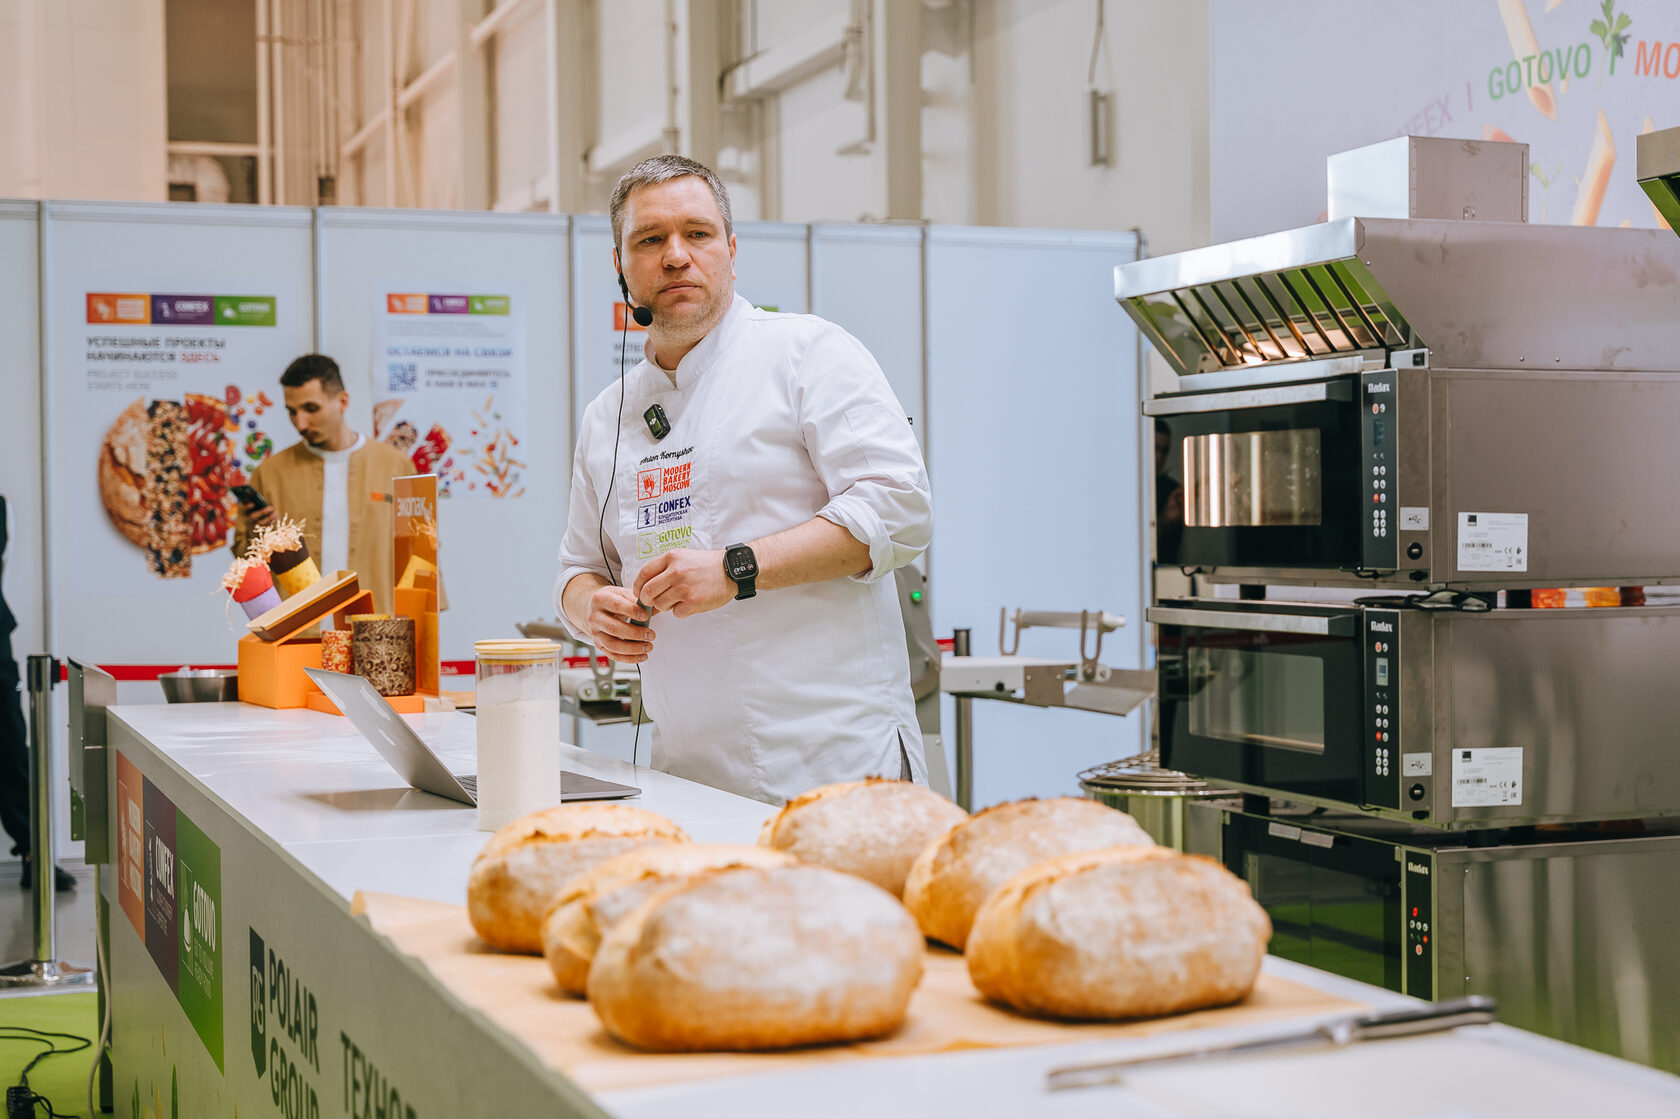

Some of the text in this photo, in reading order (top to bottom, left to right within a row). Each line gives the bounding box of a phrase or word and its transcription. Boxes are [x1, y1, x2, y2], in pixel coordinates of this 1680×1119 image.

[1488, 43, 1592, 101] GOTOVO
[86, 337, 225, 349] УСПЕШНЫЕ ПРОЕКТЫ
[86, 352, 220, 363] НАЧИНАЮТСЯ ЗДЕСЬ
[663, 461, 692, 477] MODERN
[663, 470, 691, 486] BAKERY
[662, 478, 691, 494] MOSCOW
[658, 495, 691, 514] CONFEX
[659, 525, 692, 543] GOTOVO
[155, 835, 175, 900] CONFEX
[193, 880, 216, 952] GOTOVO
[269, 947, 320, 1076] POLAIR
